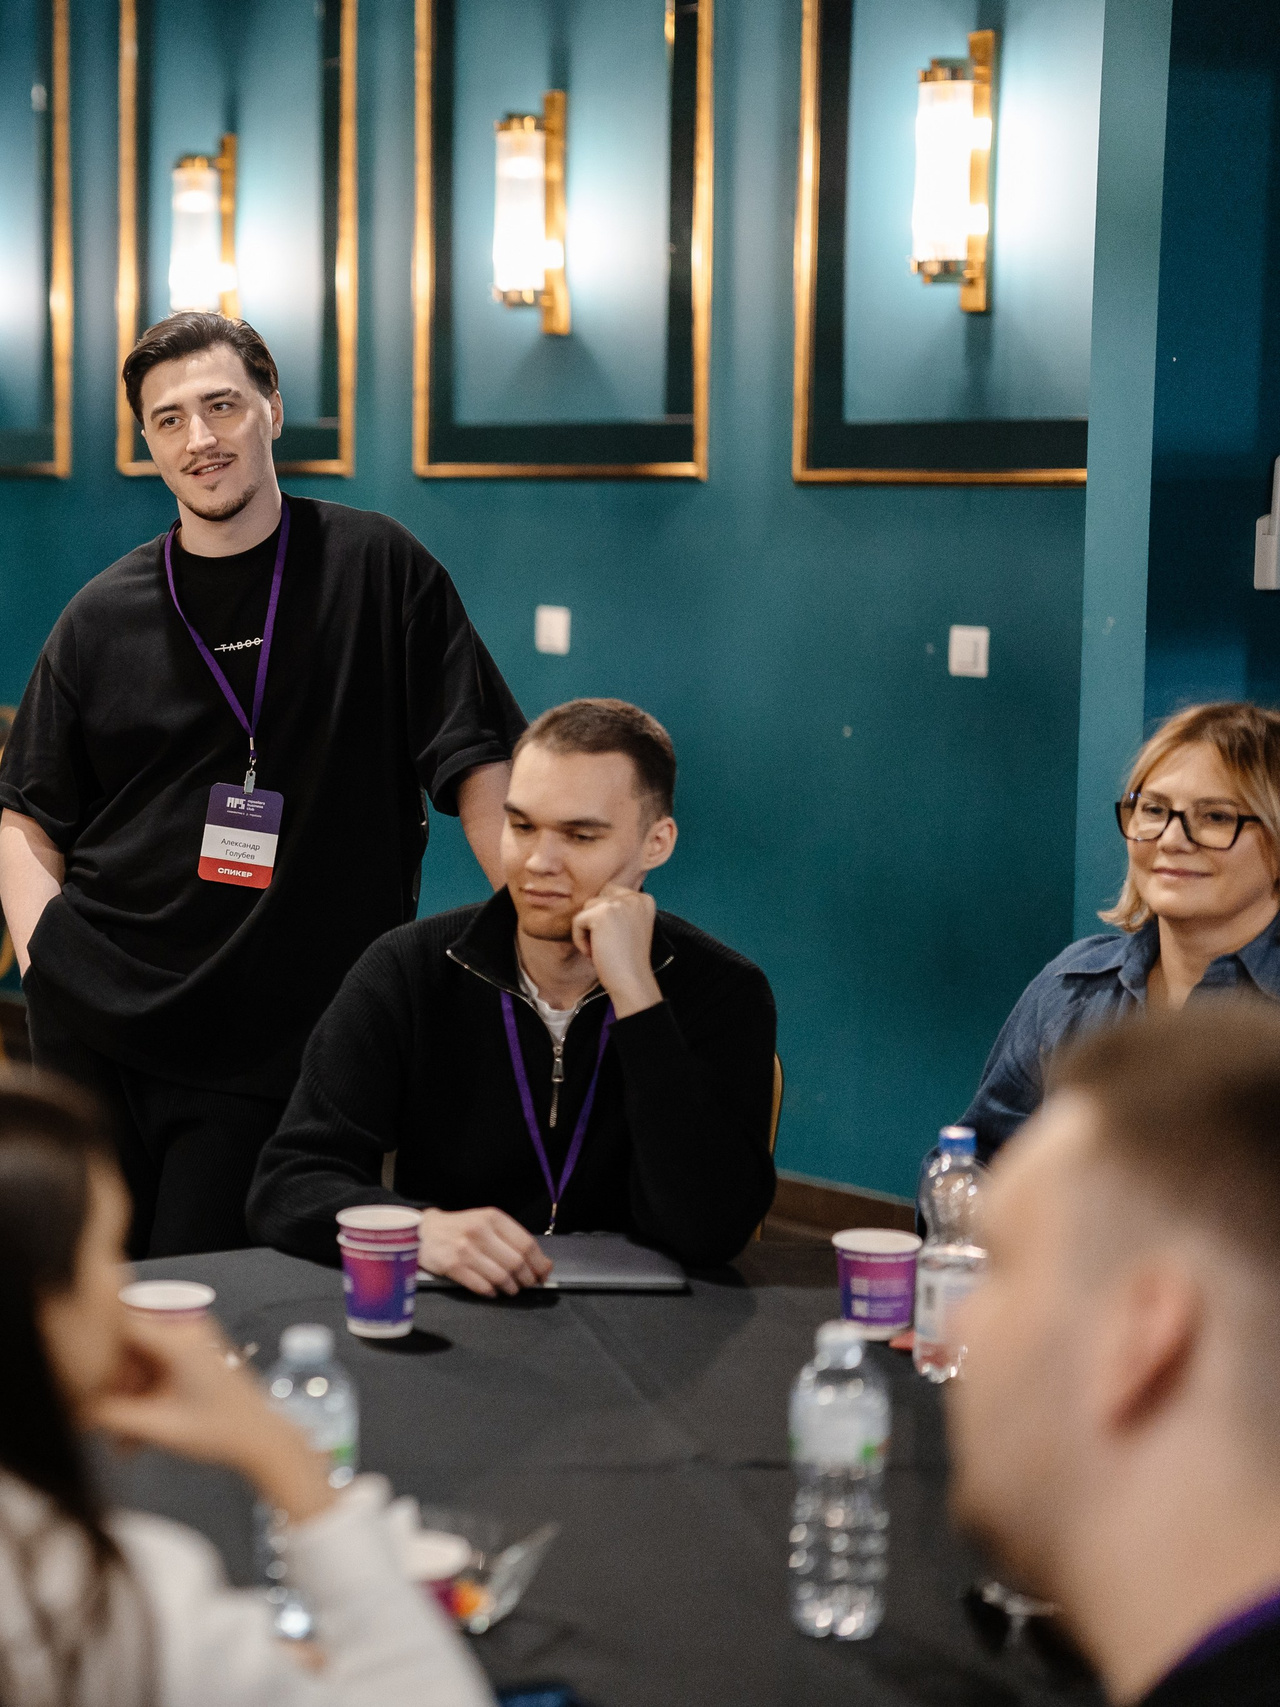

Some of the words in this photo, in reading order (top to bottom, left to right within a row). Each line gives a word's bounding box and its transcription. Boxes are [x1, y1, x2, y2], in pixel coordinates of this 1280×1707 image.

[219, 637, 262, 652] TABOO
[221, 838, 260, 850] Александр
[225, 849, 256, 860] Голубев
[217, 867, 253, 878] СПИКЕР
